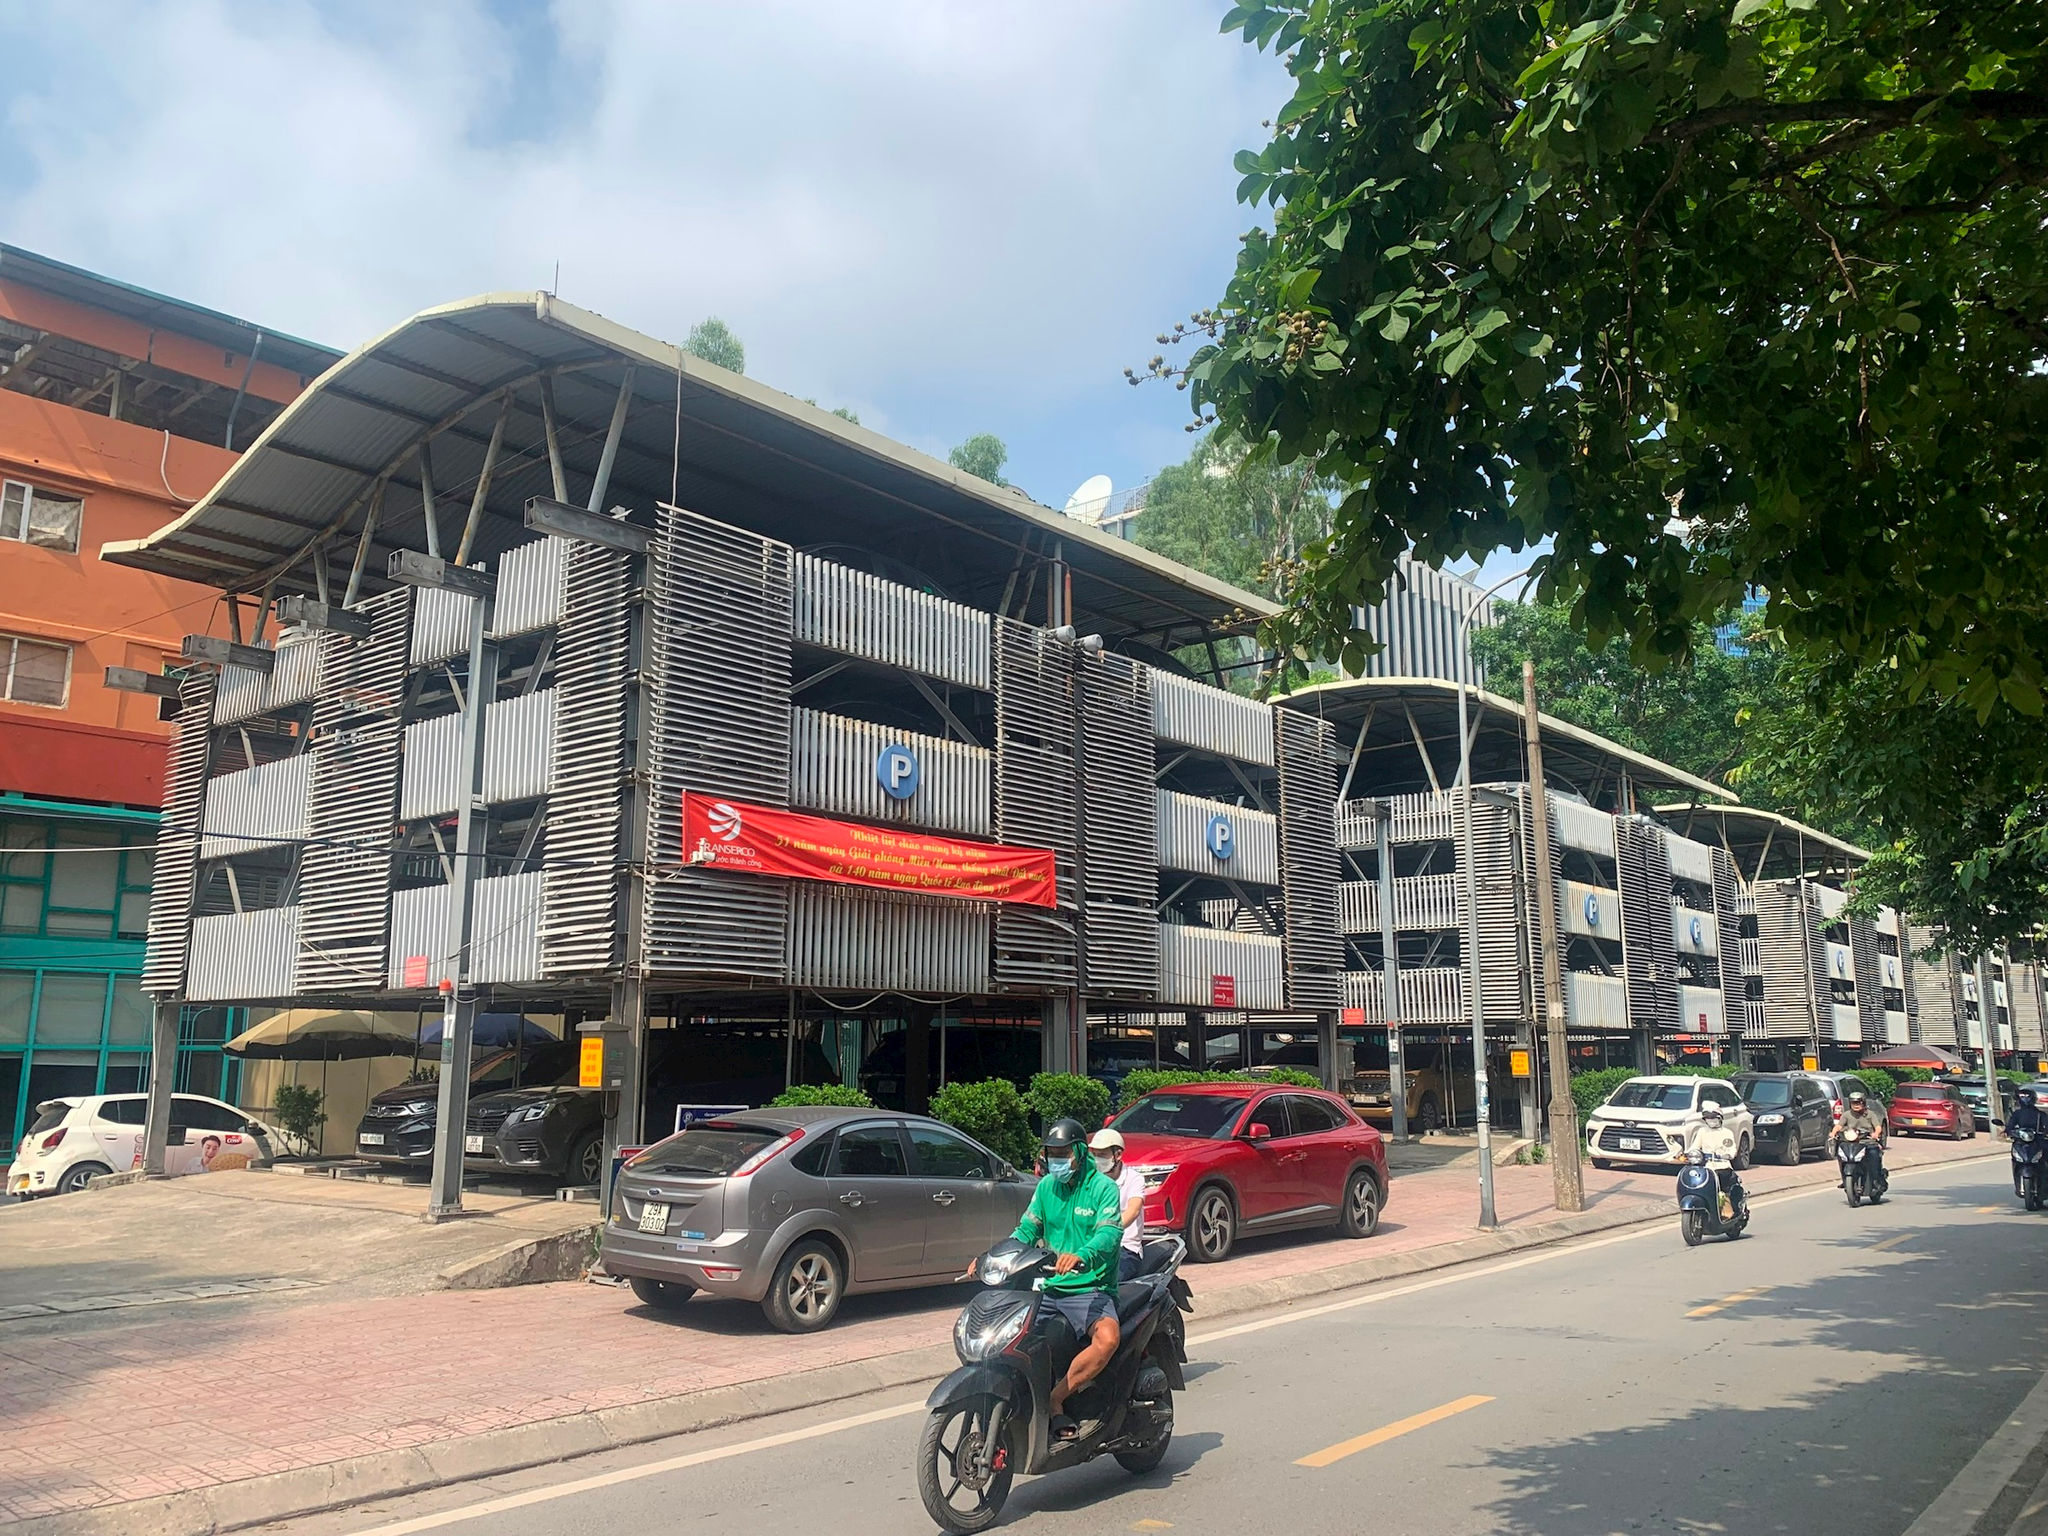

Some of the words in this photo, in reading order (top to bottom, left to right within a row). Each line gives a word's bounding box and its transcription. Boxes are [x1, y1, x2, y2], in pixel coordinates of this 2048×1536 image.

[891, 753, 912, 788] P
[850, 830, 879, 846] Nhiệt
[881, 835, 896, 849] liệt
[898, 839, 921, 850] chào
[923, 843, 950, 857] mừng
[965, 848, 988, 861] niệm
[1215, 822, 1230, 850] P
[697, 842, 755, 857] RANSERCO
[793, 839, 817, 851] năm
[819, 843, 846, 858] ngày
[848, 846, 872, 860] Giải
[874, 850, 905, 866] phóng
[907, 854, 931, 868] Miền
[962, 861, 988, 876] thống
[990, 865, 1009, 878] nhất
[828, 862, 843, 875] và
[846, 864, 867, 878] 140
[868, 867, 891, 879] năm
[893, 871, 918, 885] ngày
[920, 871, 943, 887] Quốc
[953, 877, 971, 889] Lao
[972, 879, 995, 894] động
[997, 883, 1010, 896] 1/5
[1590, 899, 1598, 919] P
[1694, 920, 1700, 939] P
[1389, 1039, 1399, 1052] 15
[648, 1202, 663, 1217] 29A
[1074, 1206, 1094, 1216] Grab
